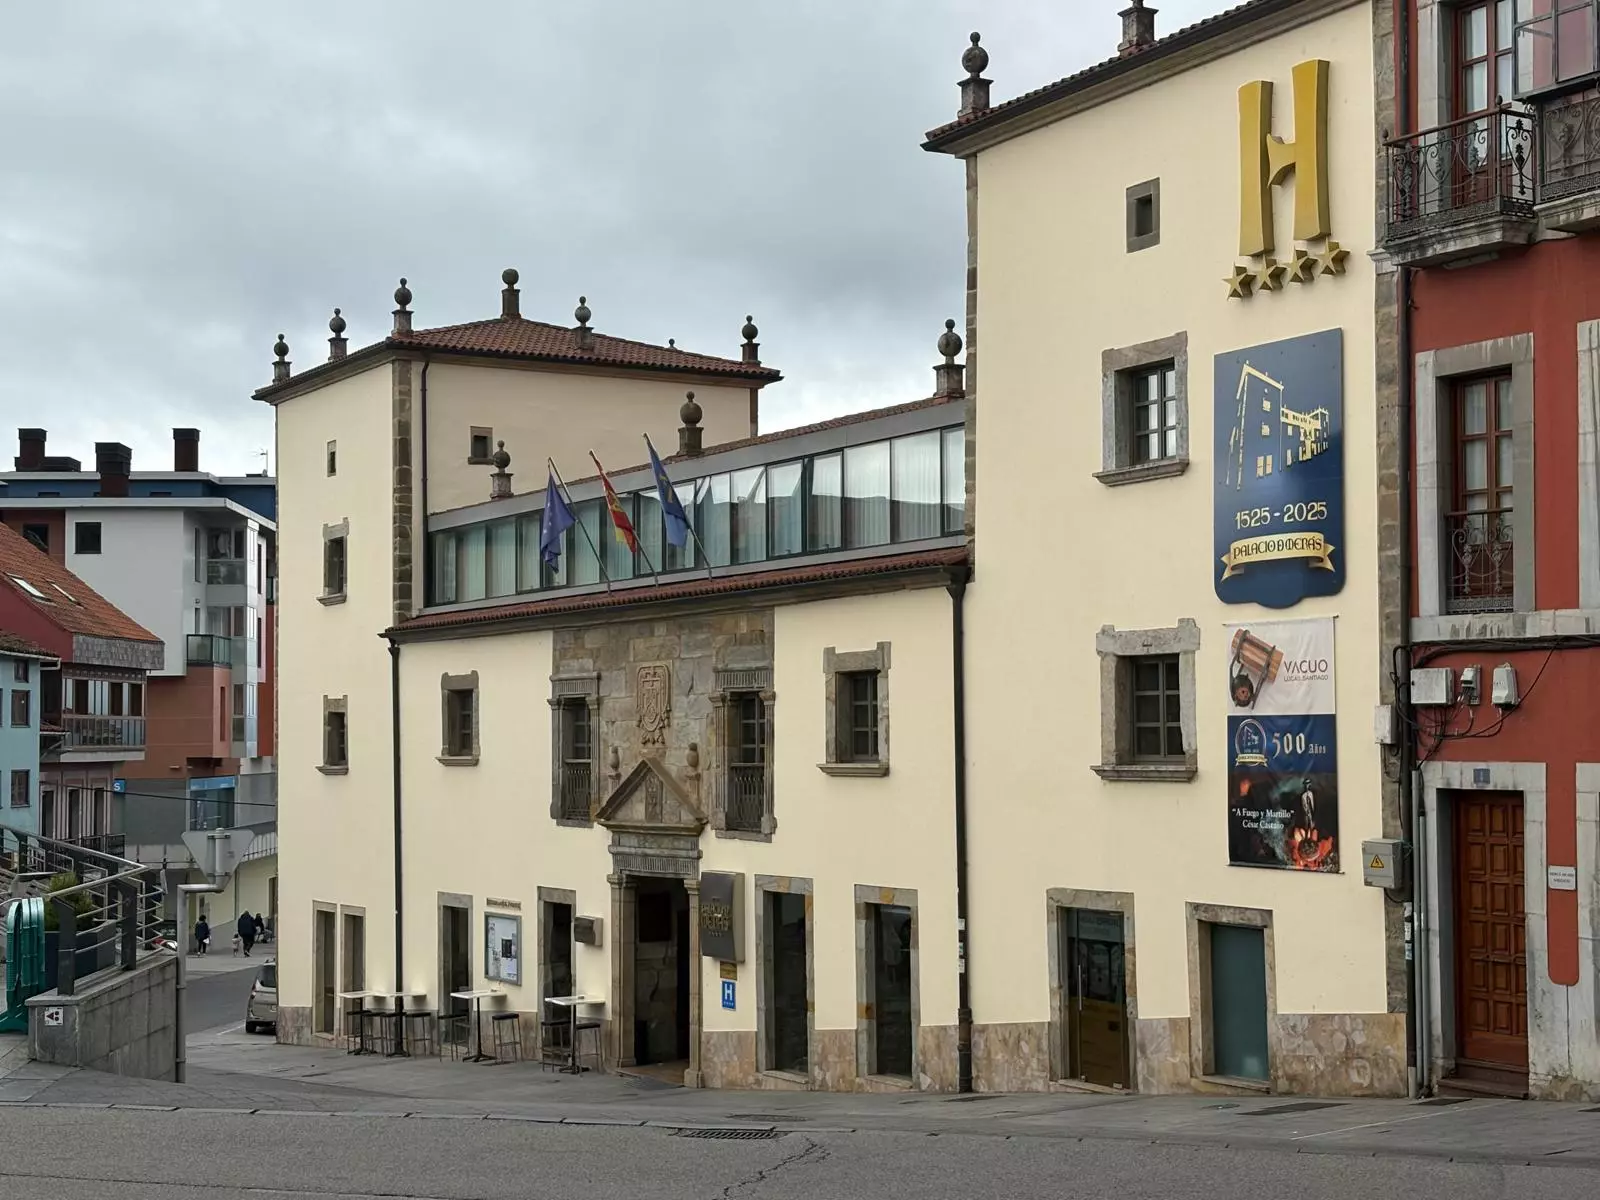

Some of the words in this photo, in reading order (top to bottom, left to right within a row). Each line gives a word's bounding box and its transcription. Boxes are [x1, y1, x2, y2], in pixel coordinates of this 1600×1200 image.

[1237, 59, 1332, 257] H
[1233, 539, 1276, 560] PALACIO
[1284, 659, 1328, 674] VACUO
[1302, 674, 1329, 682] SANTIAGO
[1271, 732, 1306, 760] 500
[1308, 743, 1326, 754] Años
[1242, 808, 1260, 819] Fuego
[1242, 819, 1259, 829] César
[724, 983, 733, 1001] H
